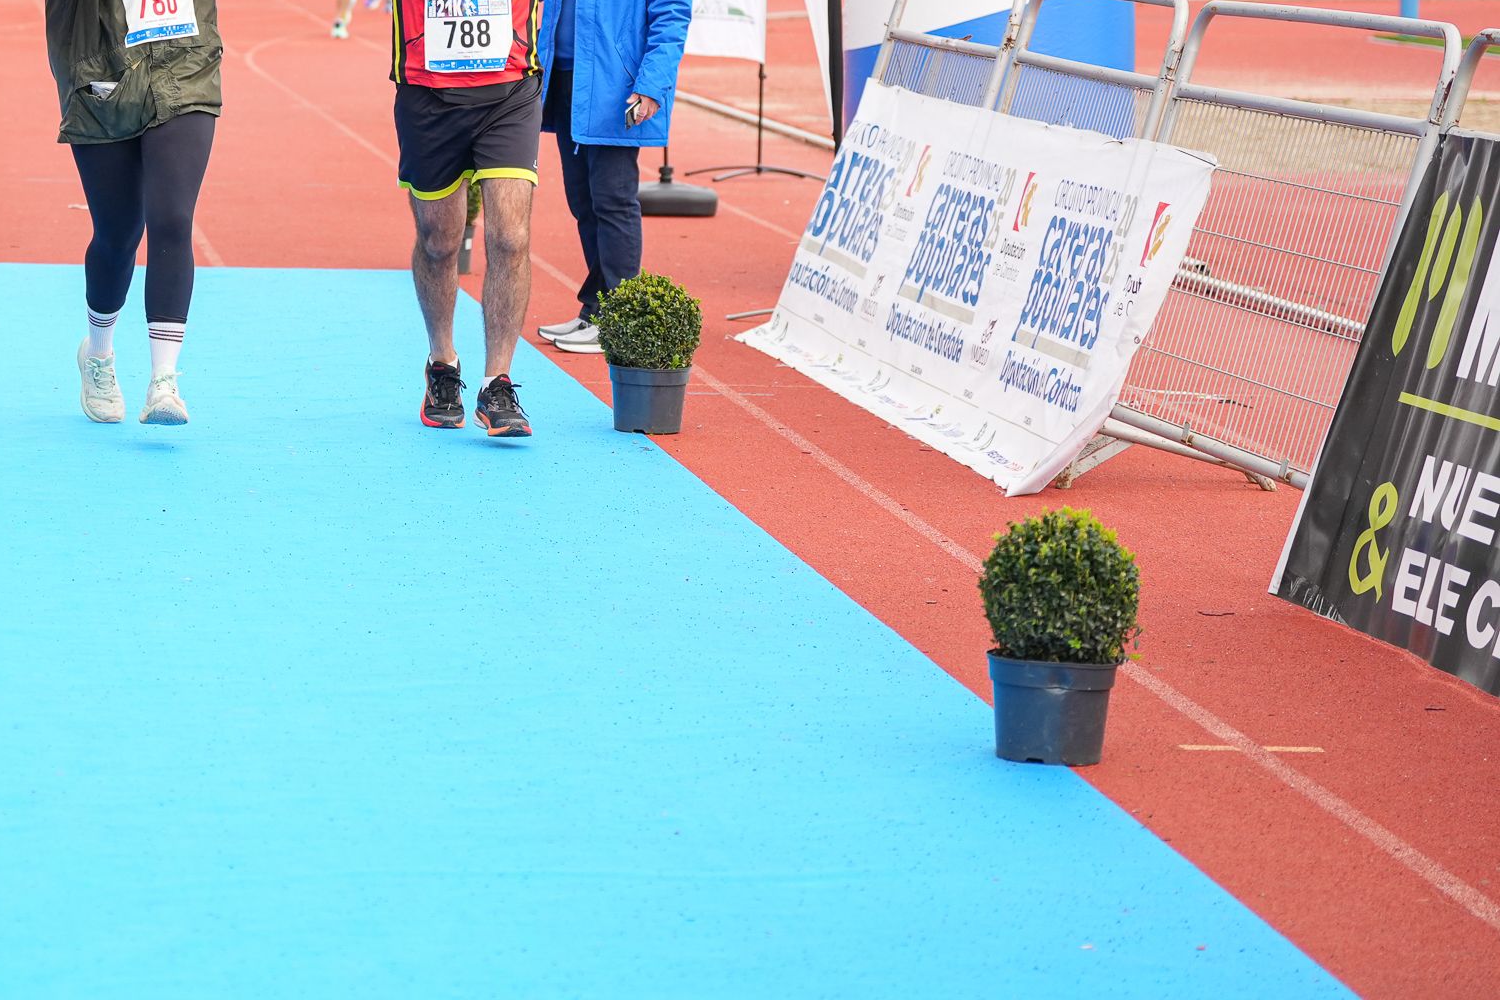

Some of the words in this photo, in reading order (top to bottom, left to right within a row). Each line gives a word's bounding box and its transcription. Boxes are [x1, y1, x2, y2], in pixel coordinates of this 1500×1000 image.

[444, 19, 491, 48] 788
[997, 167, 1017, 207] 20
[807, 190, 884, 264] opulares
[924, 183, 994, 251] carreras
[984, 210, 1005, 249] 25
[1116, 194, 1138, 238] 20
[897, 231, 991, 307] populares
[1039, 215, 1113, 285] carreras
[1101, 241, 1124, 285] 25
[789, 262, 830, 301] putación
[885, 303, 929, 347] Diputación
[1011, 268, 1110, 349] populares
[1349, 481, 1398, 603] &
